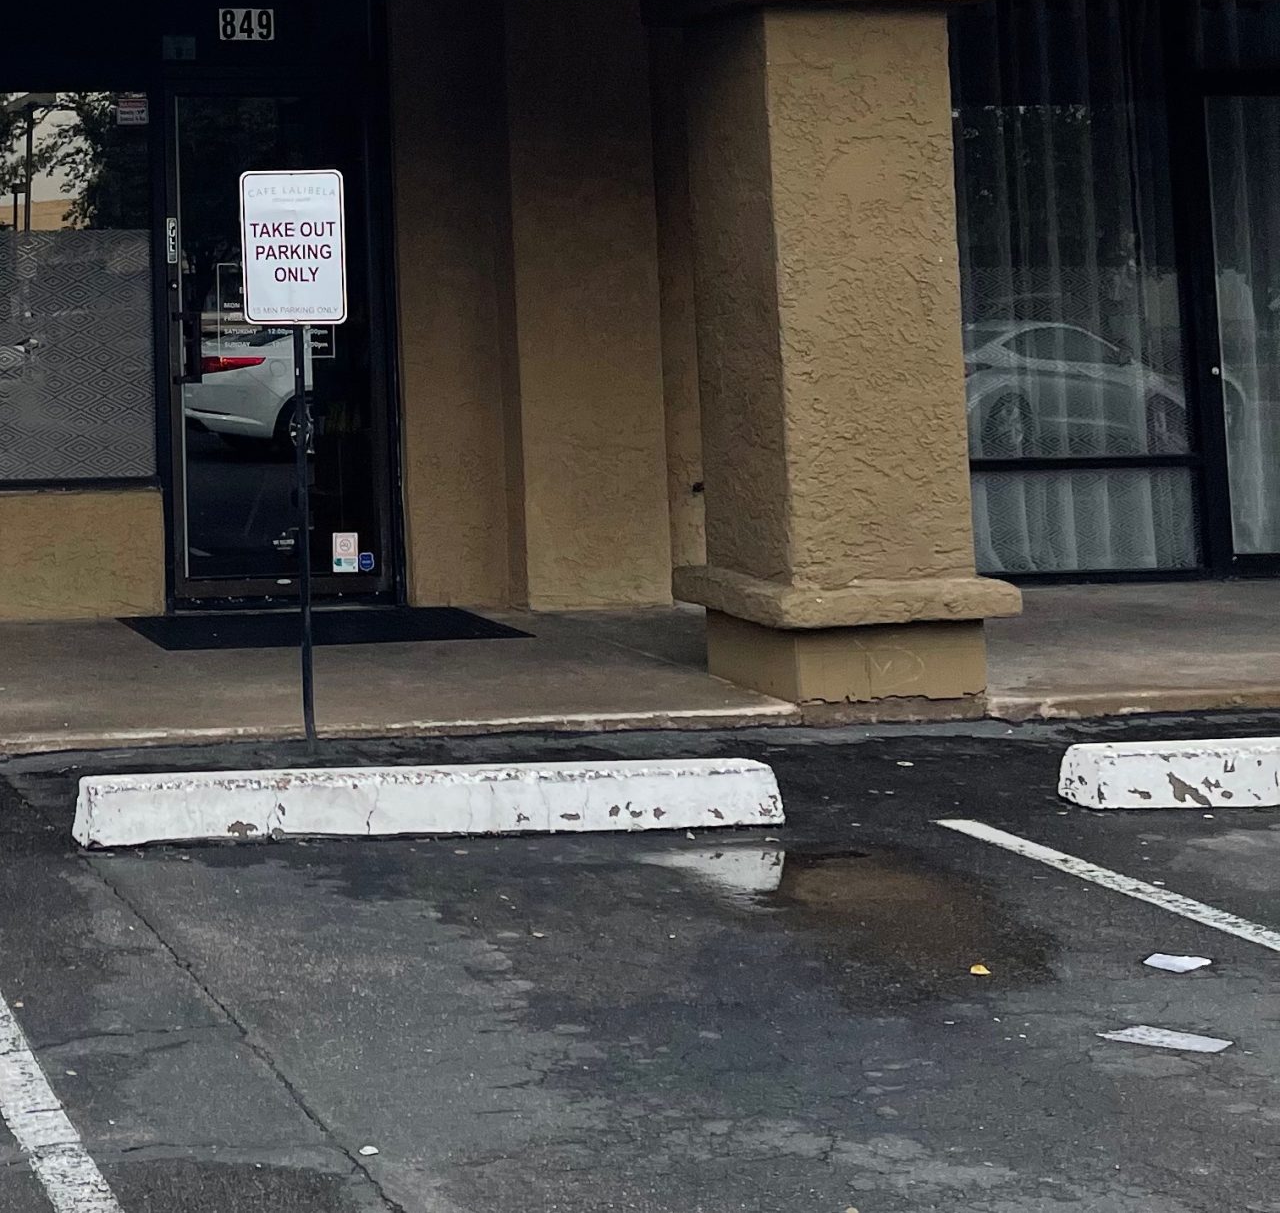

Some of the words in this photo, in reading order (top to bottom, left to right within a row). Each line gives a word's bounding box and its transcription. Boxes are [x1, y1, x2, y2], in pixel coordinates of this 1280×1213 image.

[221, 9, 272, 39] 849
[247, 186, 277, 198] CAFE
[282, 186, 336, 196] LALIBELA
[250, 222, 295, 238] TAKE
[300, 221, 336, 237] OUT
[255, 244, 332, 260] PARKING
[274, 267, 320, 282] ONLY
[263, 306, 278, 315] MIN
[280, 306, 315, 314] PARKING
[317, 306, 338, 314] ONLY
